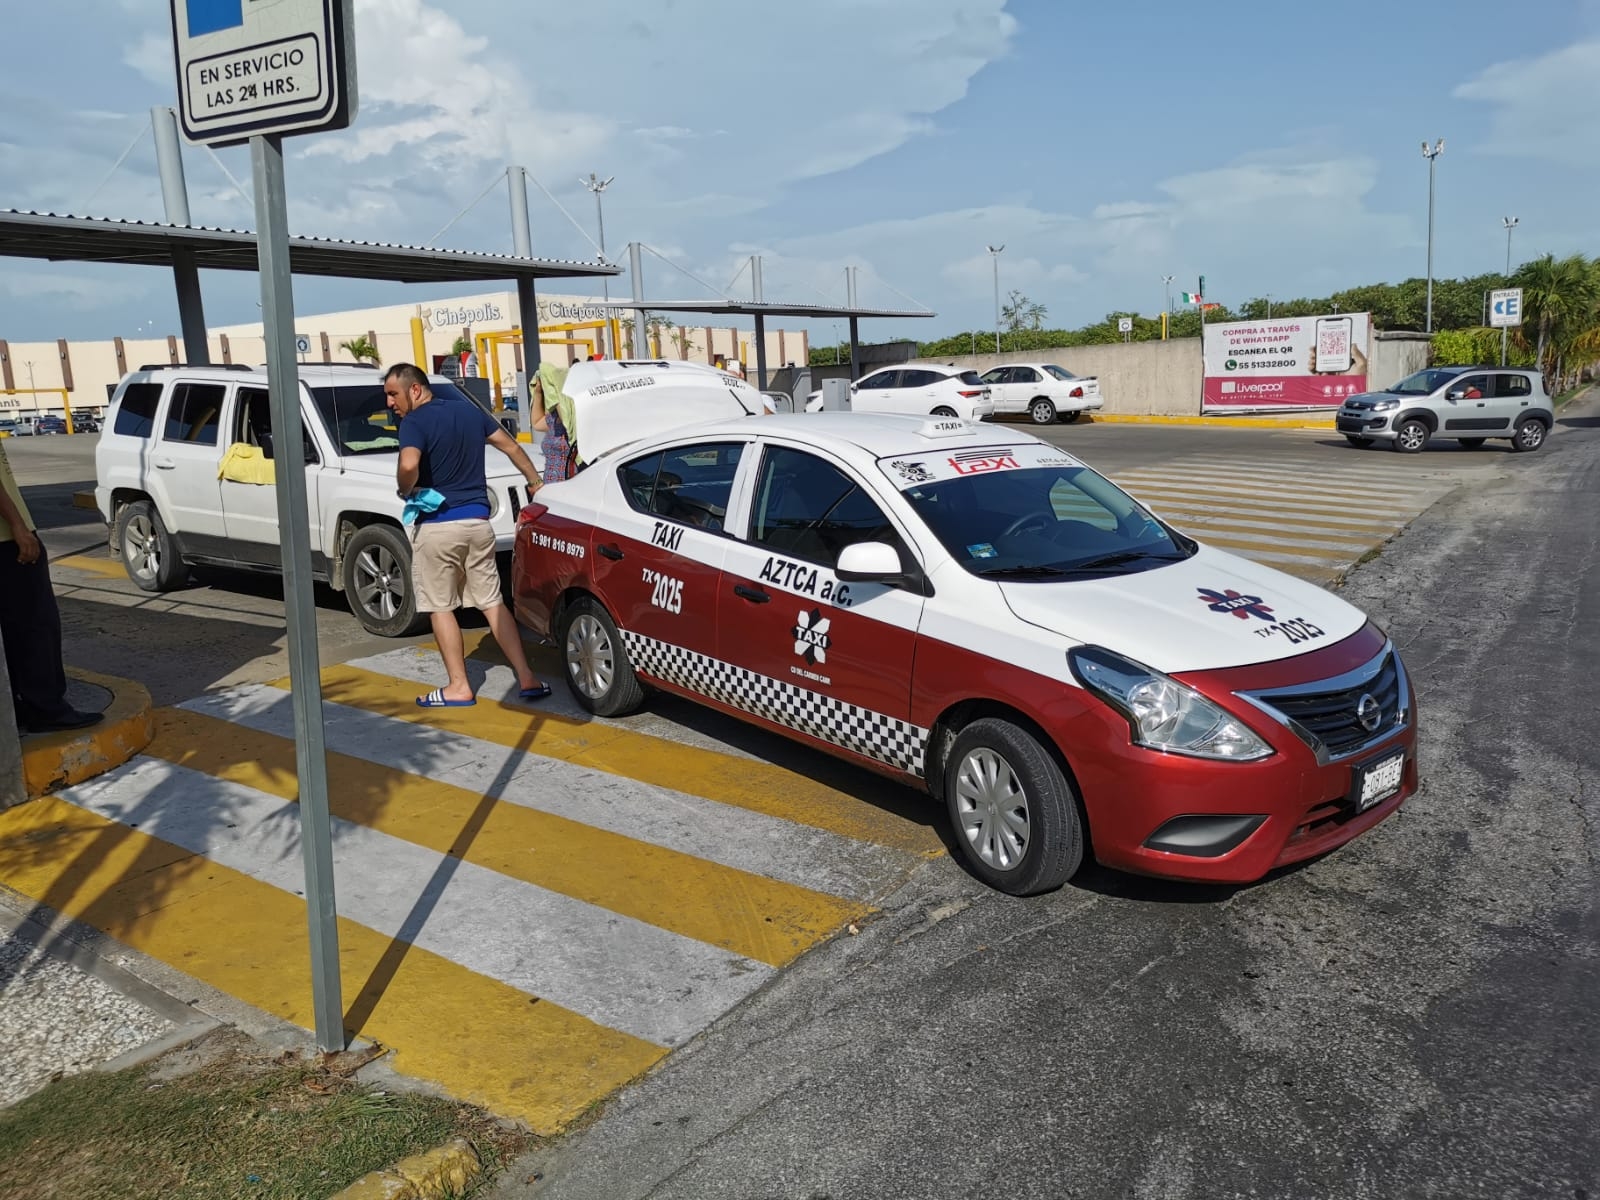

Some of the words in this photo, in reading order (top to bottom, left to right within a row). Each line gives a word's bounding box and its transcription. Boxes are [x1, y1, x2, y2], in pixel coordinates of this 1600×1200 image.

[200, 67, 219, 85] EN
[225, 49, 304, 80] SERVICIO
[206, 89, 234, 108] LAS
[239, 83, 258, 101] 24
[263, 76, 300, 97] HRS.
[1222, 328, 1258, 337] COMPRA
[1266, 325, 1301, 334] TRAVÉS
[1230, 337, 1242, 345] DE
[1242, 335, 1290, 344] WHATSAPP
[1228, 347, 1267, 356] ESCANEA
[1281, 346, 1293, 354] QR
[1250, 359, 1296, 369] 51332800
[1236, 381, 1283, 394] Liverpool
[531, 532, 539, 544] T:
[539, 533, 551, 548] 981
[552, 539, 566, 553] 816
[566, 542, 585, 559] 8979
[651, 521, 684, 551] TAXI
[642, 567, 653, 584] TX
[651, 573, 684, 615] 2025
[759, 556, 818, 595] AZTCA
[820, 580, 853, 606] a.c.
[1217, 597, 1256, 609] TAXI
[796, 626, 828, 648] TAXI
[1253, 627, 1275, 638] TX
[1270, 617, 1326, 644] 2025
